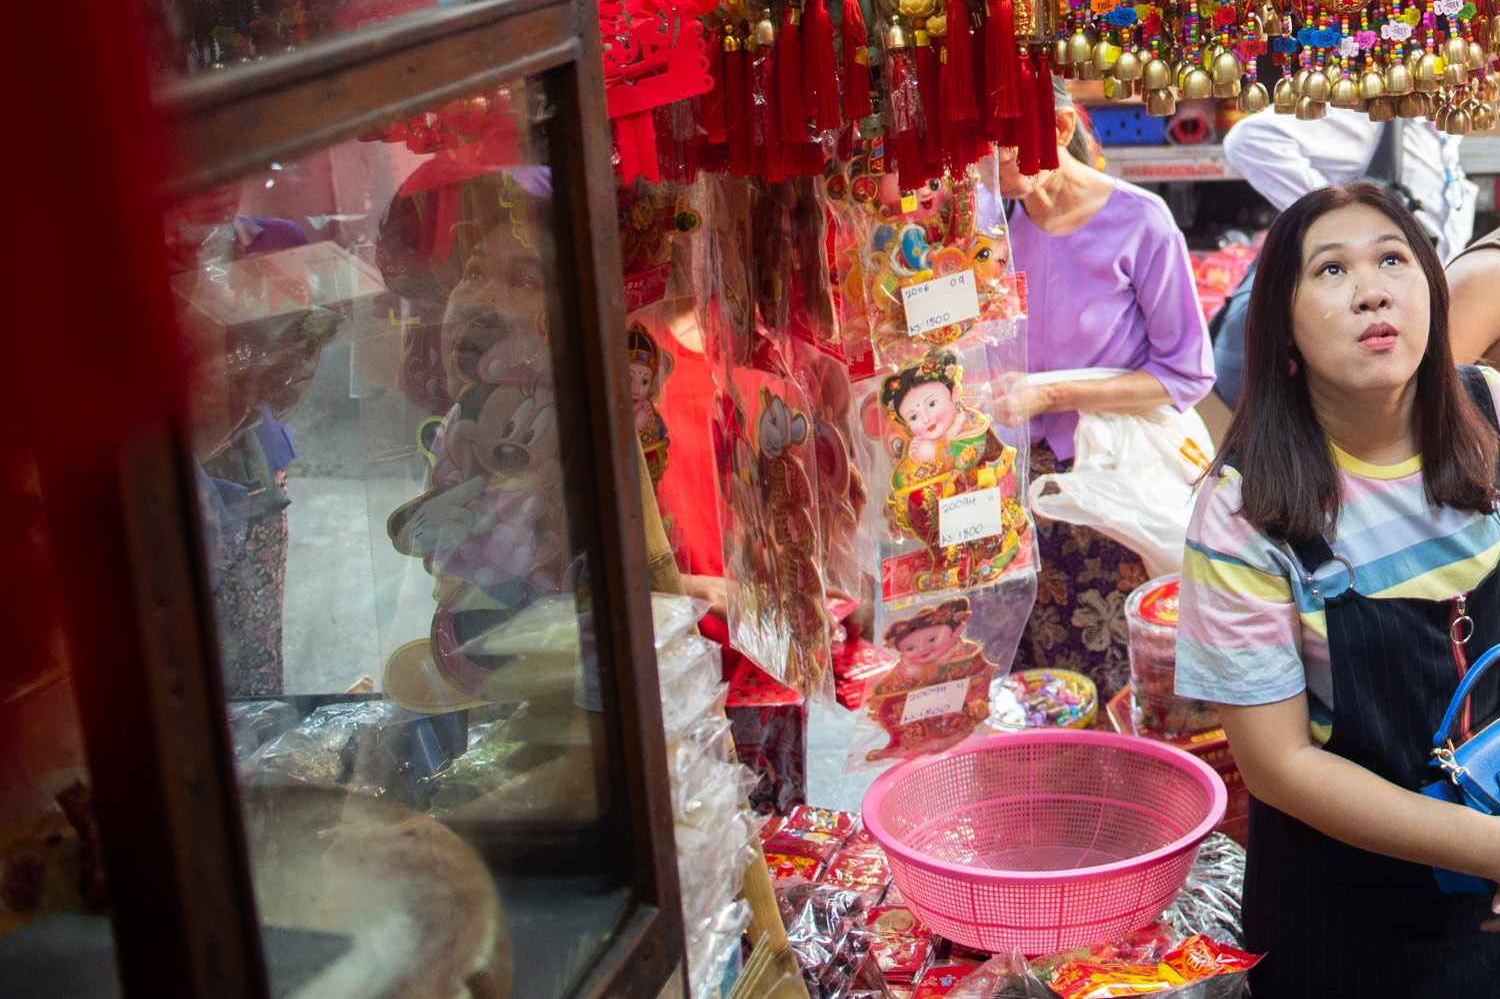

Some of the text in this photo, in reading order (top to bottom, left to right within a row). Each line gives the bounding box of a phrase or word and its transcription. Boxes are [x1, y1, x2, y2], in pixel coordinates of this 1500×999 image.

[950, 275, 965, 287] 09
[926, 312, 950, 327] 1500
[942, 497, 976, 514] 20094
[958, 523, 984, 540] 1800
